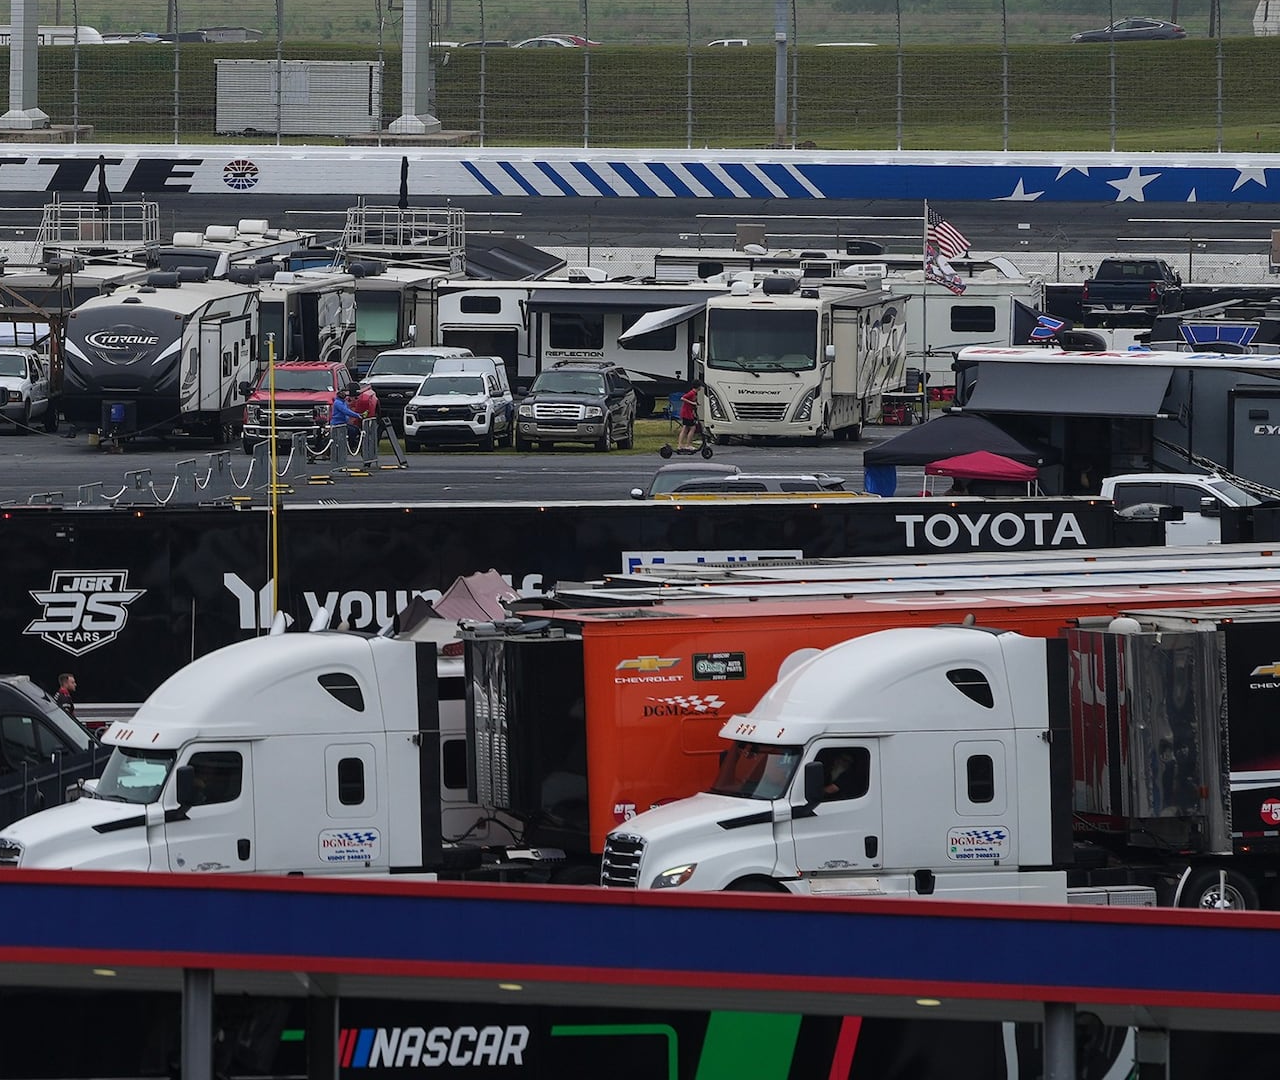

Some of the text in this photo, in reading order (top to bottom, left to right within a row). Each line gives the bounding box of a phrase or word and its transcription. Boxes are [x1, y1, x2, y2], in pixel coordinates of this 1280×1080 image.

[100, 335, 159, 345] TORQUE
[895, 512, 1086, 548] TOYOTA
[63, 576, 114, 591] JGR
[28, 592, 139, 631] 35
[57, 632, 100, 643] YEARS
[615, 675, 683, 683] CHEVROLET
[644, 705, 678, 717] DGM
[323, 839, 346, 847] DGM
[951, 837, 975, 845] DGM
[368, 1025, 529, 1068] NASCAR
